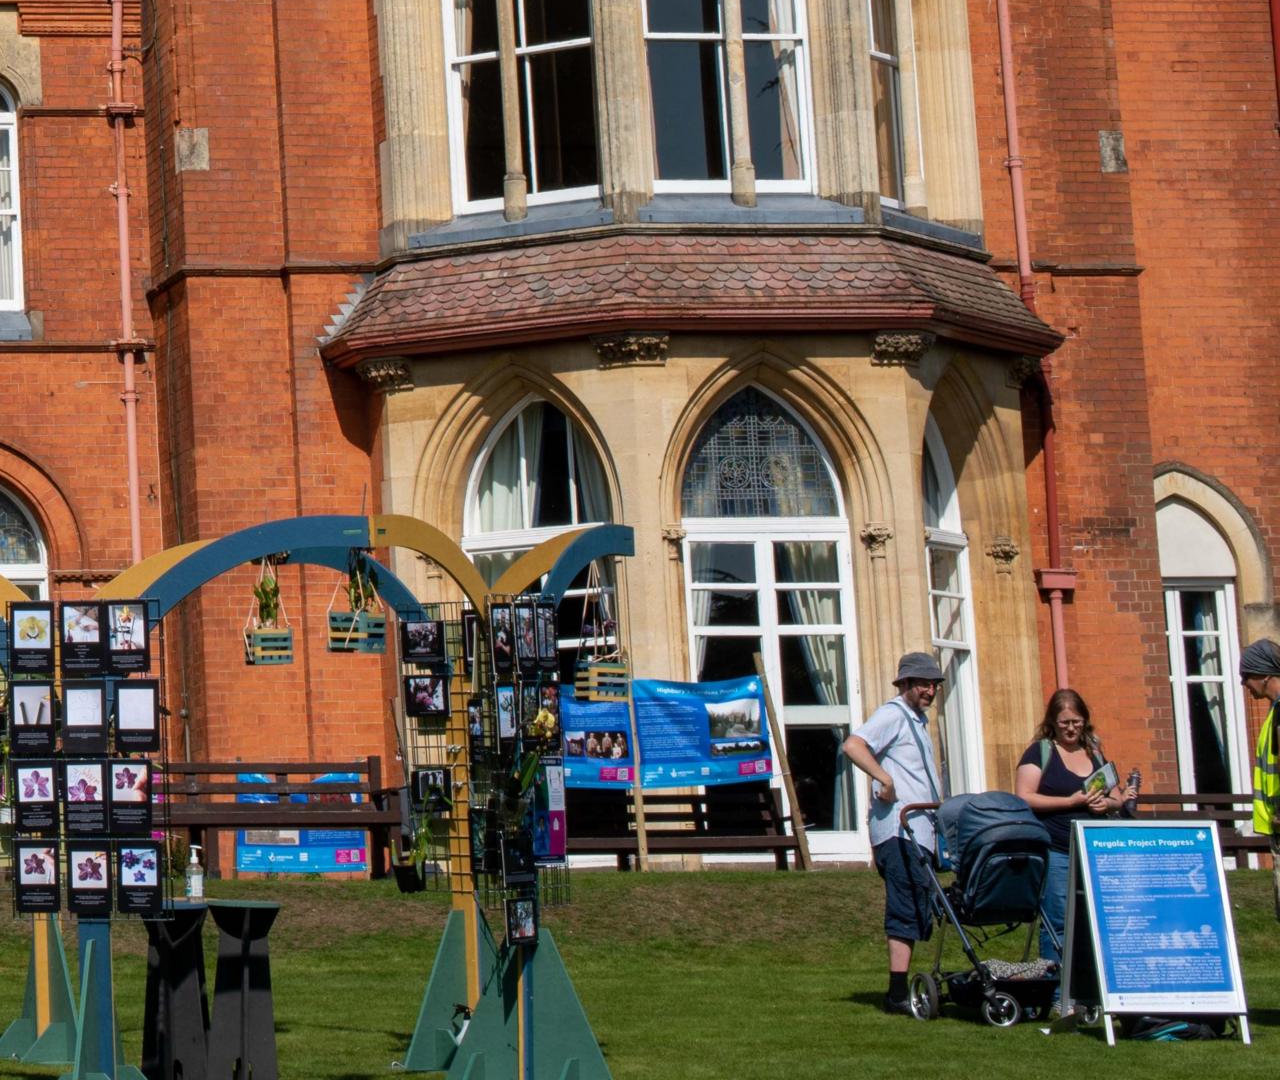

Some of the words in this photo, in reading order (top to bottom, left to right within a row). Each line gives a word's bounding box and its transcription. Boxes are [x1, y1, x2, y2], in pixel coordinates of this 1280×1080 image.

[1093, 839, 1127, 849] Pergola:
[1128, 838, 1156, 848] Project
[1158, 838, 1194, 848] Progress
